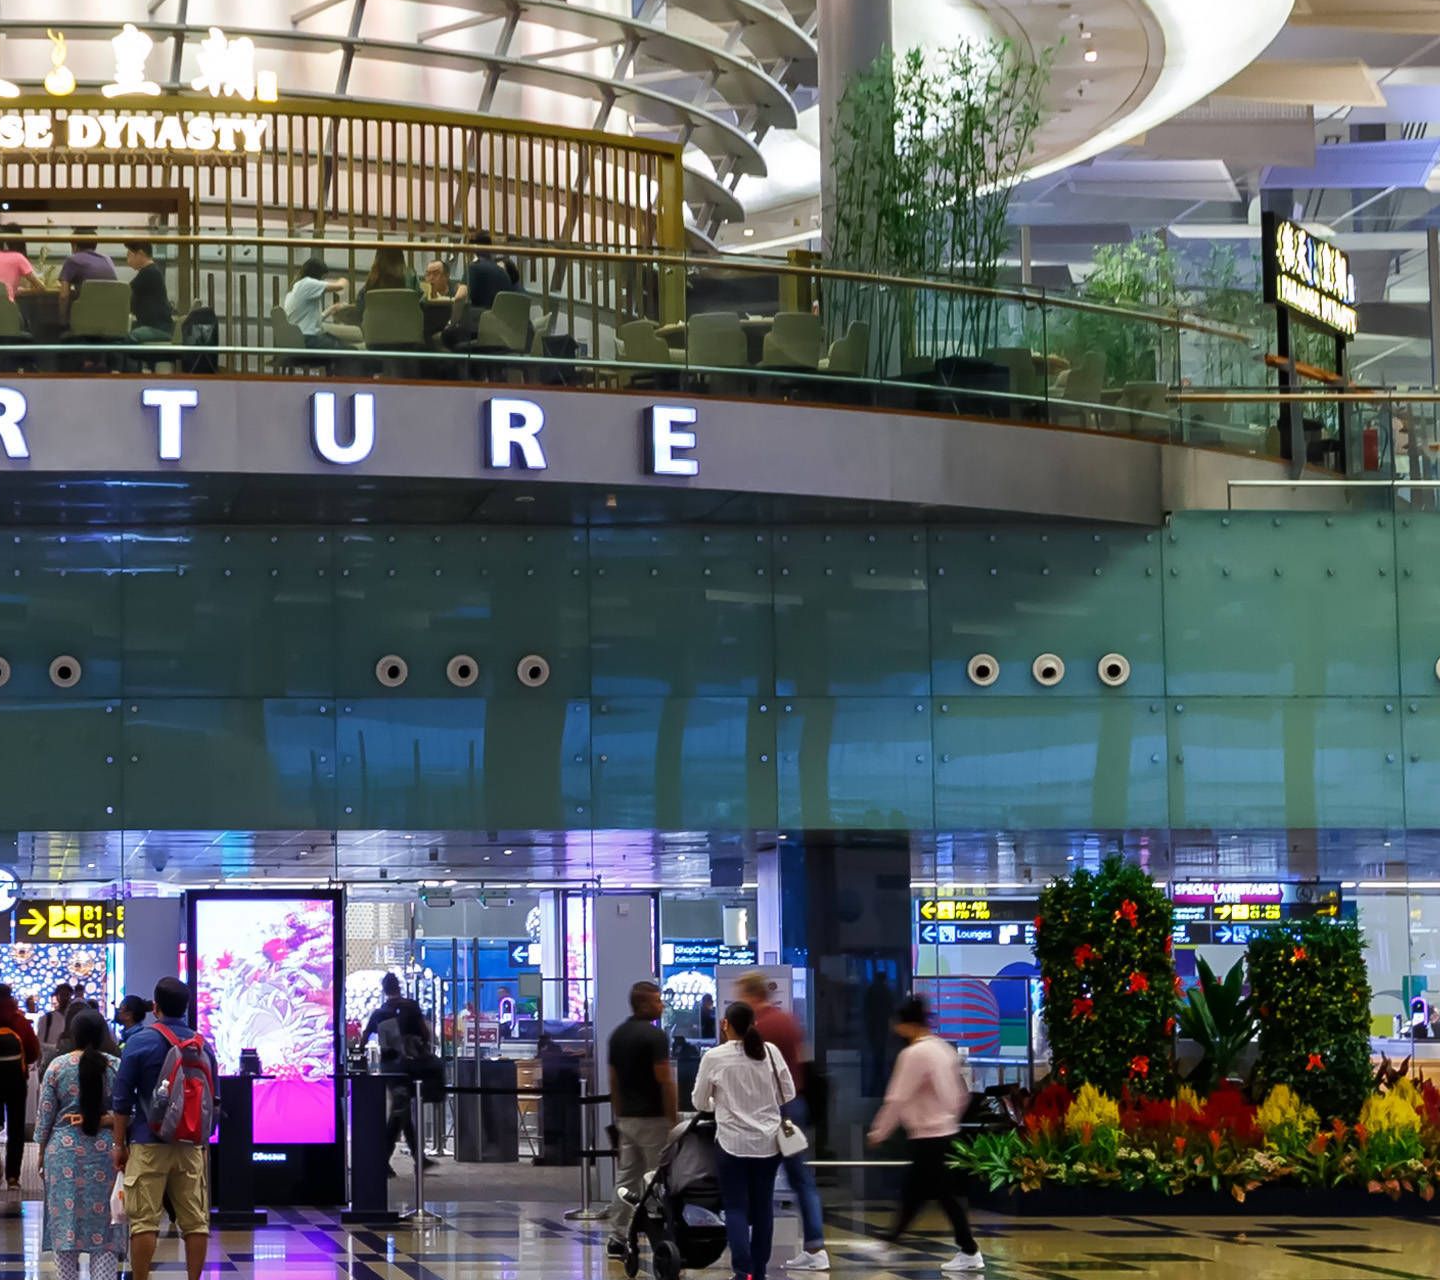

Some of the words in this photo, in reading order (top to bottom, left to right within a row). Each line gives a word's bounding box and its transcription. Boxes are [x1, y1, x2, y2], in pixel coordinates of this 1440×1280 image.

[68, 116, 268, 152] DYNASTY
[1175, 883, 1216, 895] SPECIAL
[1214, 894, 1241, 904] LANE
[83, 905, 103, 921] B1
[82, 922, 103, 939] C1
[956, 929, 993, 941] Lounges
